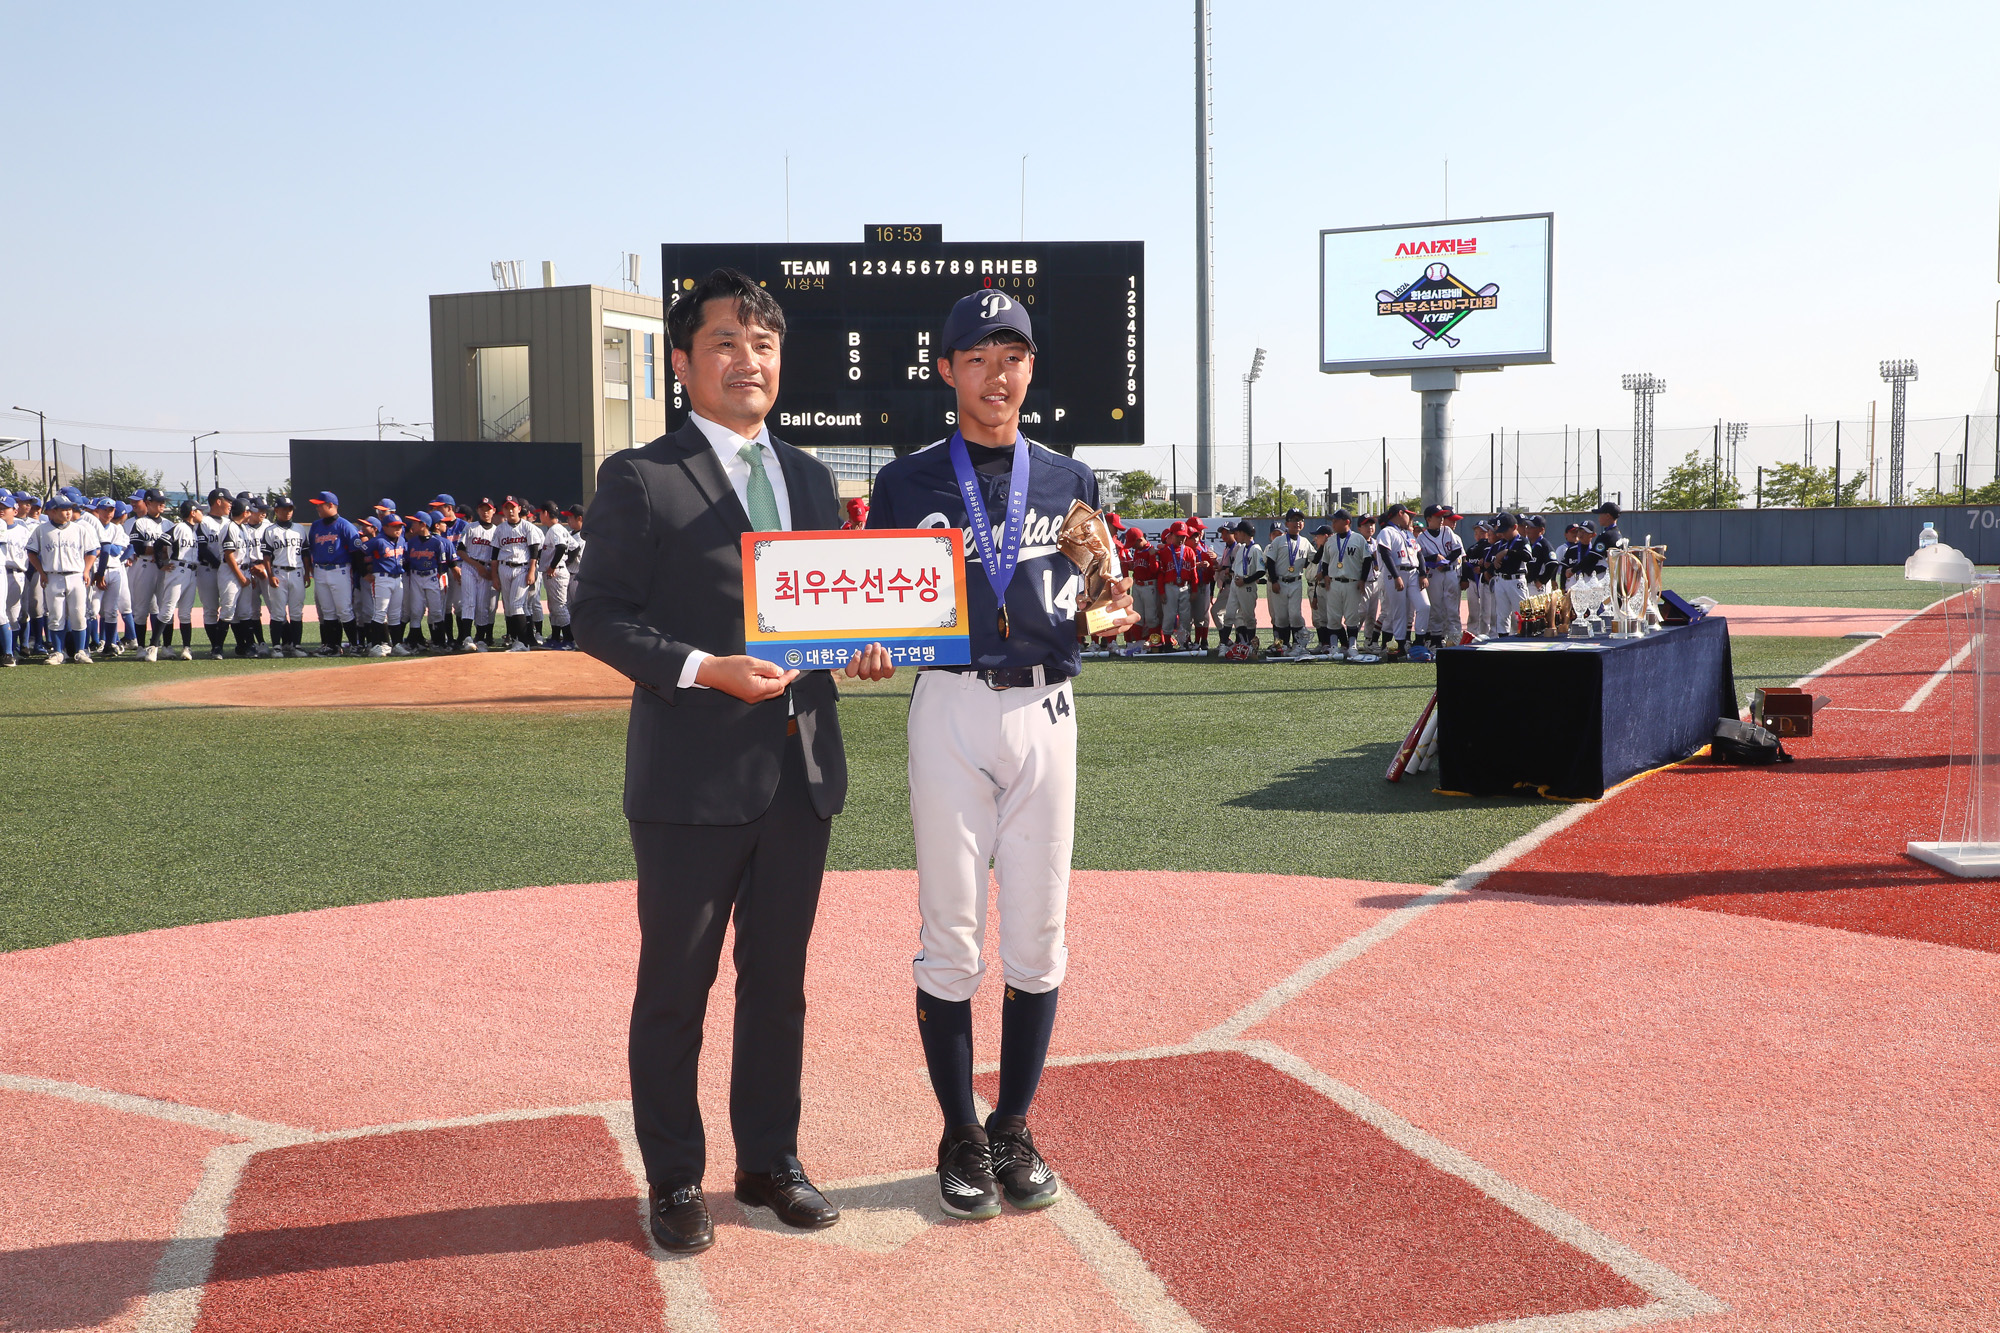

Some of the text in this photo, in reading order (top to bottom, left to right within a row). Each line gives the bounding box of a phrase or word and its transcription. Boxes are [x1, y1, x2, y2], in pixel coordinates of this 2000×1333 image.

[876, 226, 922, 242] 16:53
[1395, 238, 1476, 255] 시사저널
[781, 261, 830, 275] TEAM
[672, 278, 679, 291] 1
[785, 278, 825, 291] 시상식
[983, 277, 1035, 289] 0 0 0 0
[1128, 275, 1135, 288] 1
[1393, 282, 1410, 296] 2024
[1410, 288, 1462, 300] 화성시장배
[1027, 294, 1035, 305] 0
[1127, 290, 1136, 303] 2
[980, 293, 1012, 318] P
[1127, 305, 1136, 318] 3
[1378, 296, 1496, 315] 전국유소년야구대회
[1421, 312, 1455, 323] KYBF
[1127, 320, 1136, 332] 4
[849, 332, 860, 346] B
[918, 332, 930, 346] H
[1127, 334, 1136, 347] 5
[849, 349, 860, 363] S
[918, 349, 929, 362] E
[1127, 349, 1136, 362] 6
[907, 366, 930, 380] FC
[1127, 364, 1137, 376] 7
[673, 382, 682, 395] 8
[1127, 379, 1136, 391] 8
[673, 396, 682, 409] 9
[1127, 393, 1137, 406] 9
[780, 412, 861, 426] Ball Count
[881, 413, 888, 424] 0
[1055, 408, 1065, 422] P
[501, 536, 527, 546] Giants
[1347, 547, 1357, 556] W
[774, 567, 941, 606] 최우수선수상
[1042, 569, 1078, 620] 14
[806, 645, 936, 665] 대한유구연맹
[1042, 690, 1070, 725] 14
